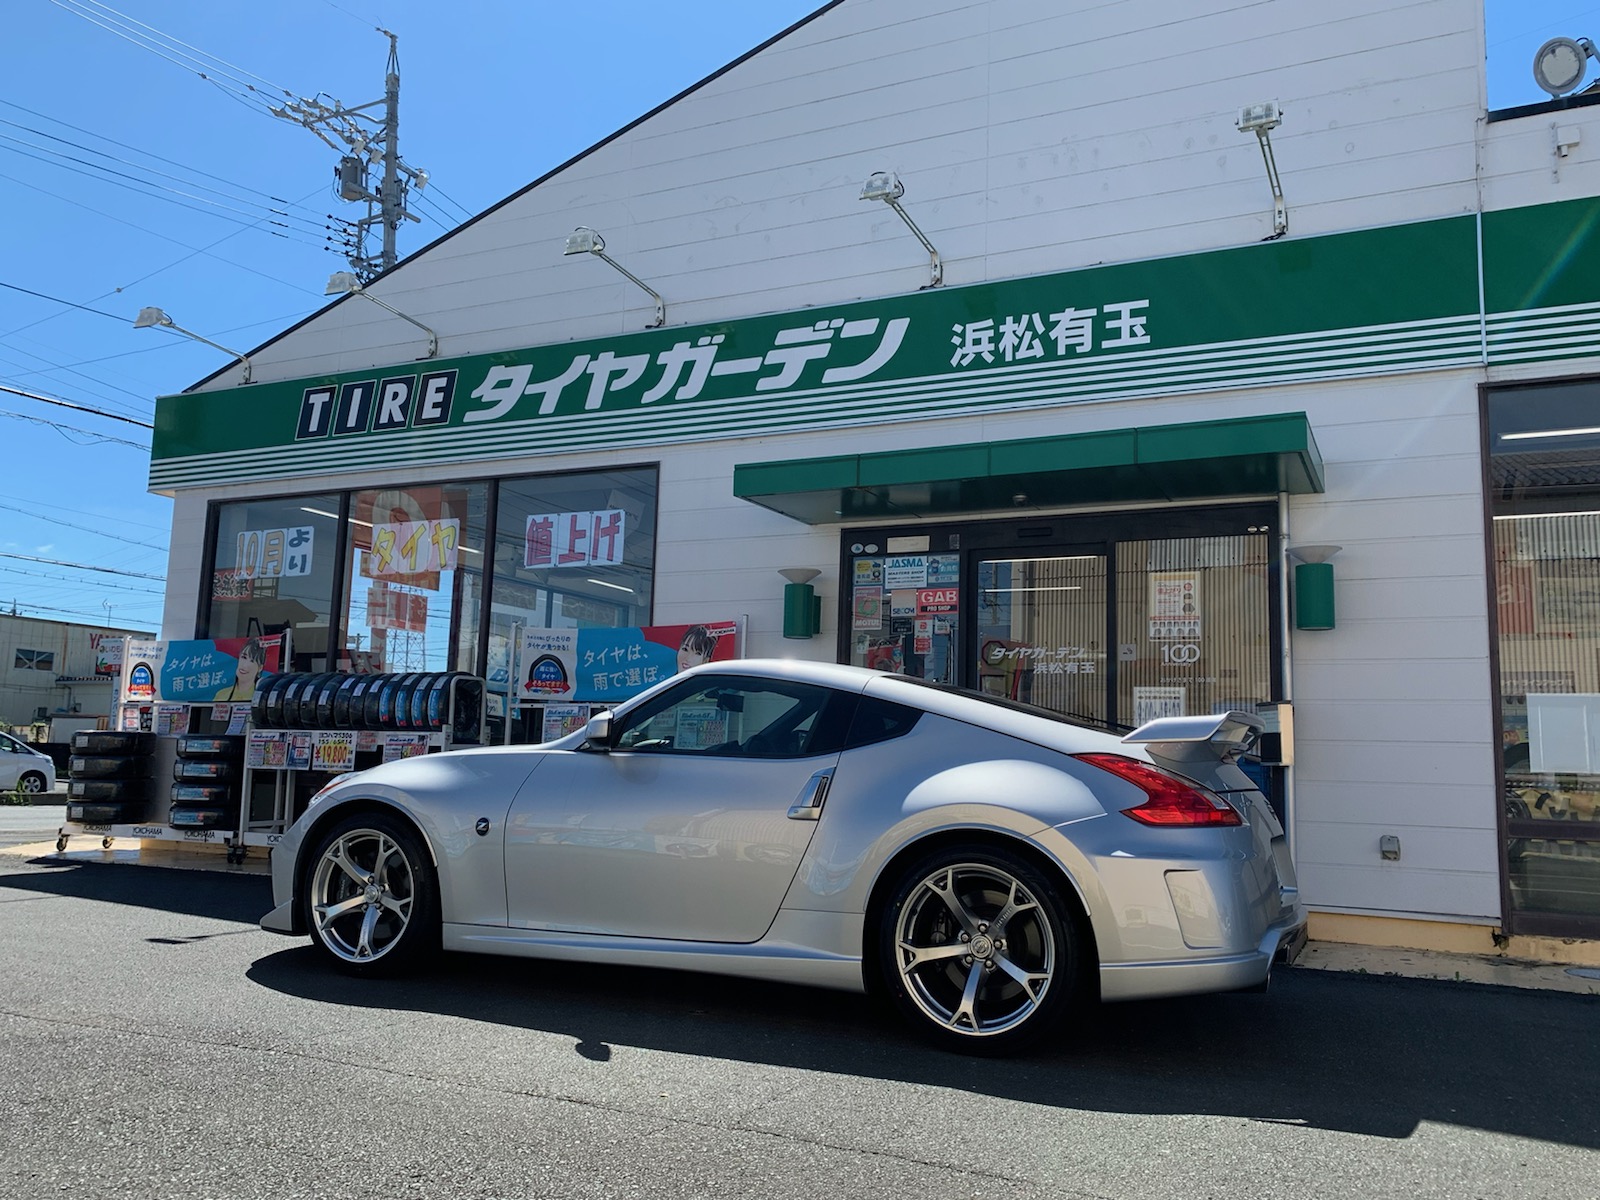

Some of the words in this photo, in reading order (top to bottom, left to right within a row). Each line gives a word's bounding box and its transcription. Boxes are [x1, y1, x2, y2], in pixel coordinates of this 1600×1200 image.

[308, 376, 448, 432] TIRE
[462, 317, 910, 423] タイヤガーデン
[950, 299, 1151, 367] 浜松有玉
[527, 511, 622, 566] 値上げ
[238, 530, 285, 576] 10月
[288, 529, 311, 573] より
[371, 522, 458, 573] タイヤ
[888, 558, 924, 569] JASMA
[921, 591, 957, 603] GAB
[892, 607, 915, 615] SECOM
[855, 619, 881, 627] MOTUL
[991, 647, 1085, 660] タイヤガーデン
[1160, 644, 1201, 663] 100
[1033, 661, 1096, 674] 浜松有玉
[82, 824, 112, 832] YOKOHAMA
[132, 827, 163, 836] YOKOHAMA
[184, 830, 216, 839] YOKOHAMA
